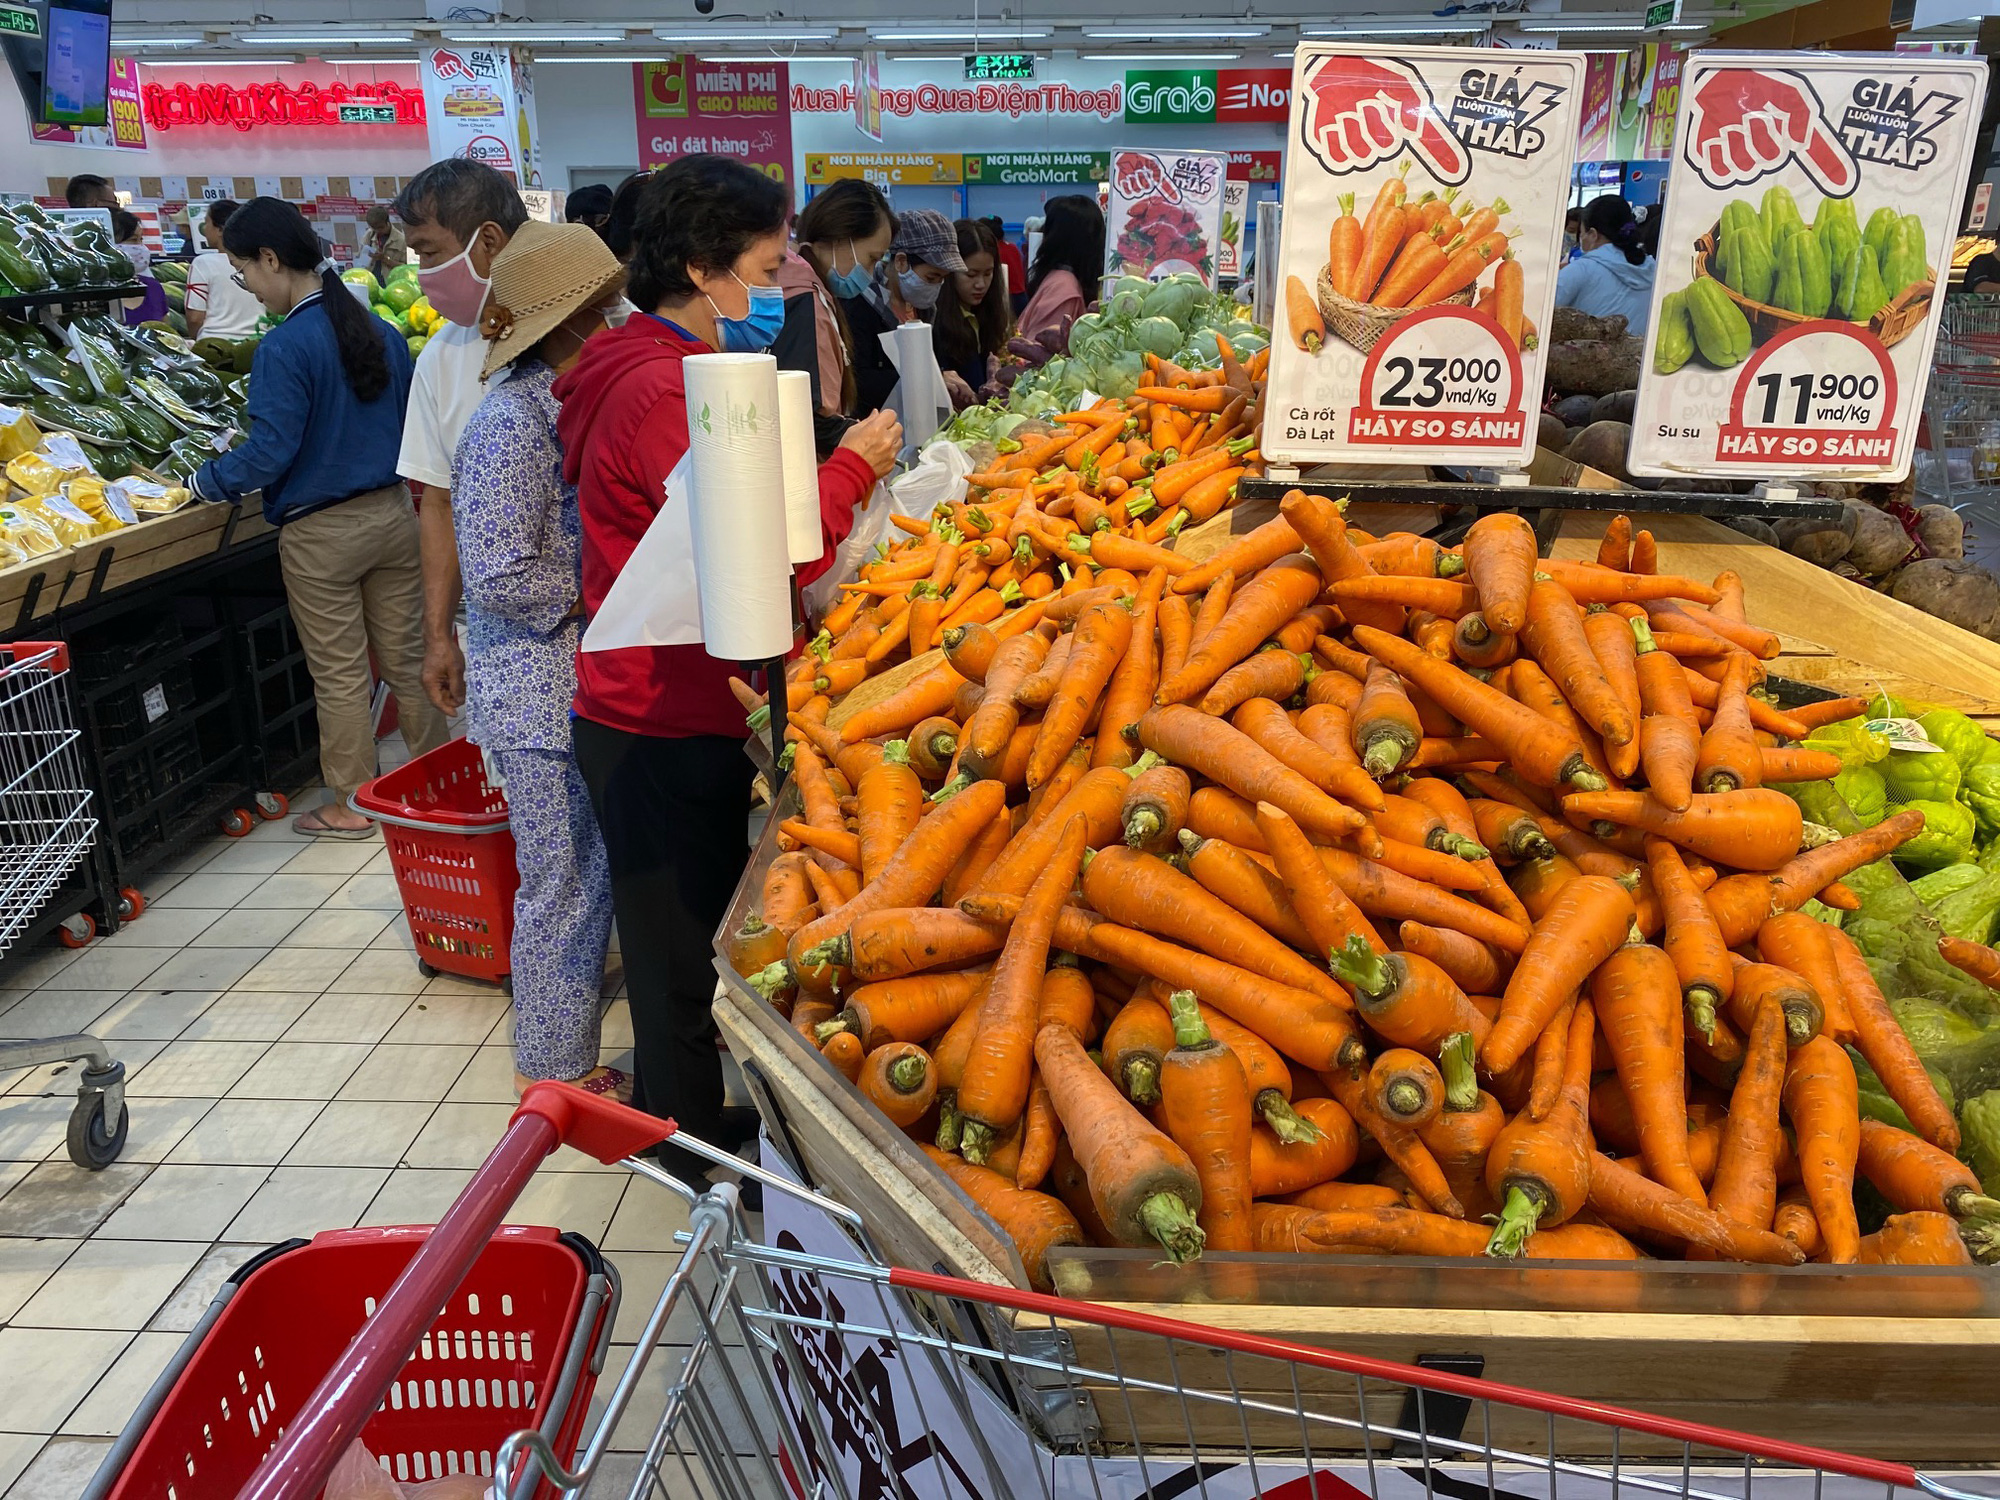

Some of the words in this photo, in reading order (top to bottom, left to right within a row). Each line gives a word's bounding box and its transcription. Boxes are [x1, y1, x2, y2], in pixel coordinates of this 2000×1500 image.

[976, 55, 1023, 67] EXIT
[695, 65, 742, 91] MIỄN
[747, 68, 777, 91] PHÍ
[1460, 66, 1523, 102] GIÁ
[697, 95, 733, 111] GIAO
[737, 93, 778, 111] HÀNG
[1127, 76, 1216, 114] Grab
[1654, 85, 1680, 117] 190
[1853, 75, 1920, 115] GIÁ
[112, 98, 139, 121] 1900
[1456, 98, 1486, 114] LUÔN
[1487, 100, 1517, 119] LUÔN
[116, 119, 142, 141] 1880
[1848, 109, 1879, 124] LUÔN
[1879, 110, 1909, 130] LUÔN
[1452, 115, 1542, 155] THẤP
[1650, 116, 1677, 147] 188
[651, 136, 677, 157] Gọi
[682, 136, 707, 153] đặt
[712, 136, 749, 157] hàng
[1843, 125, 1935, 167] THẤP
[829, 155, 852, 166] NƠI
[855, 153, 894, 168] NHẬN
[896, 153, 934, 166] HÀNG
[986, 155, 1010, 166] NƠI
[1013, 153, 1051, 167] NHẬN
[1054, 153, 1092, 165] HÀNG
[1176, 157, 1201, 173] GIÁ
[863, 169, 888, 182] Big
[892, 169, 902, 182] C
[1000, 168, 1078, 183] GrabMart
[204, 189, 217, 199] 08
[1379, 357, 1501, 408] 23.000
[1445, 387, 1497, 406] vnd/Kg
[1757, 373, 1879, 424] 11.900
[1289, 407, 1311, 420] Cà
[1313, 406, 1336, 421] rốt
[1816, 404, 1870, 424] vnd/Kg
[1286, 427, 1307, 440] Đà
[1311, 427, 1335, 443] Lạt
[1353, 415, 1407, 437] HÃY
[1410, 418, 1445, 438] SO
[1450, 417, 1521, 439] SÁNH
[1658, 425, 1678, 437] Su
[1681, 428, 1700, 439] su
[1721, 432, 1779, 455] HÃY
[1781, 437, 1818, 455] SO
[1822, 436, 1891, 457] SÁNH
